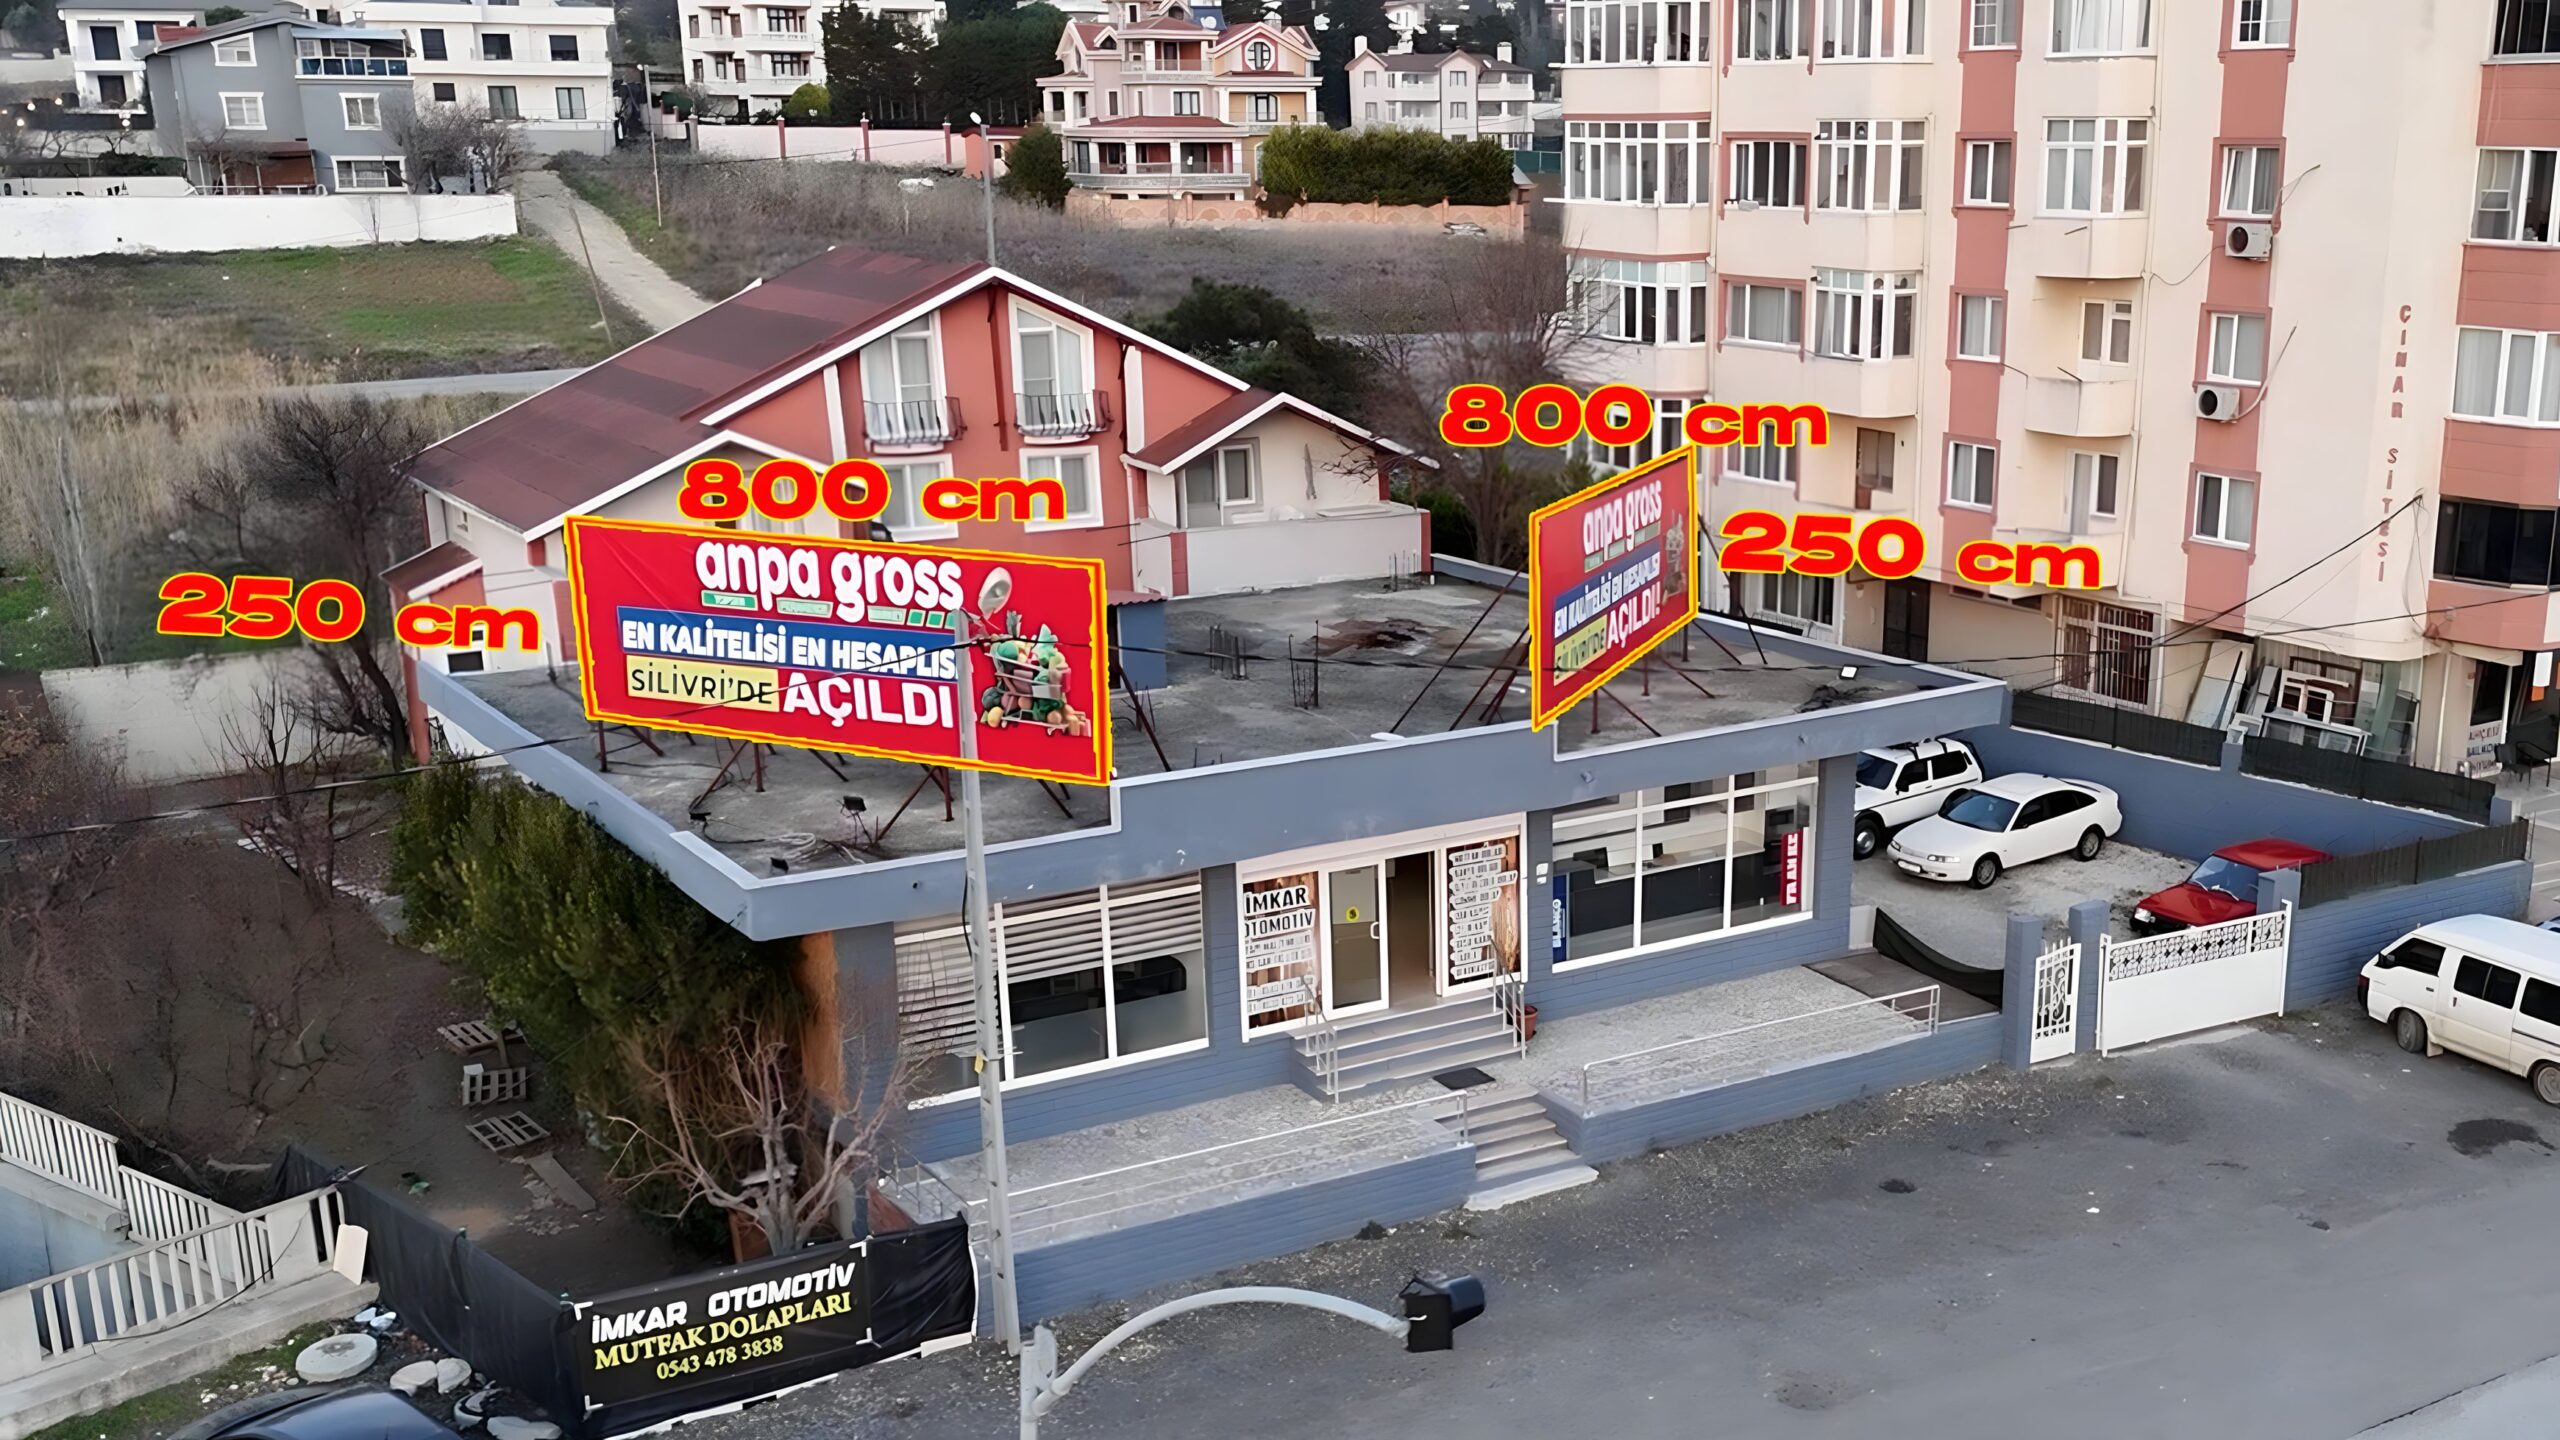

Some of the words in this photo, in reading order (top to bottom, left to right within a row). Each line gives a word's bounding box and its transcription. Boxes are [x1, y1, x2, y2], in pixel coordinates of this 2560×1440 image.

[1583, 497, 1623, 561] anpa
[1625, 480, 1662, 552] gross
[695, 541, 821, 611] anpa
[831, 551, 964, 623] gross
[1607, 581, 1660, 649] AÇILDI!
[622, 620, 655, 650] EN
[659, 618, 787, 663] KALİTELİSİ
[792, 635, 826, 667] EN
[832, 639, 958, 680] HESAPLIS
[783, 672, 954, 729] AÇILDI
[592, 1301, 687, 1343] İMKAR
[708, 1262, 855, 1317] OTOMOTİV
[594, 1326, 706, 1370] MUTFAK
[710, 1292, 851, 1344] DOLAPLARI
[656, 1355, 700, 1379] 0543
[704, 1346, 737, 1367] 478
[741, 1335, 783, 1360] 3838
